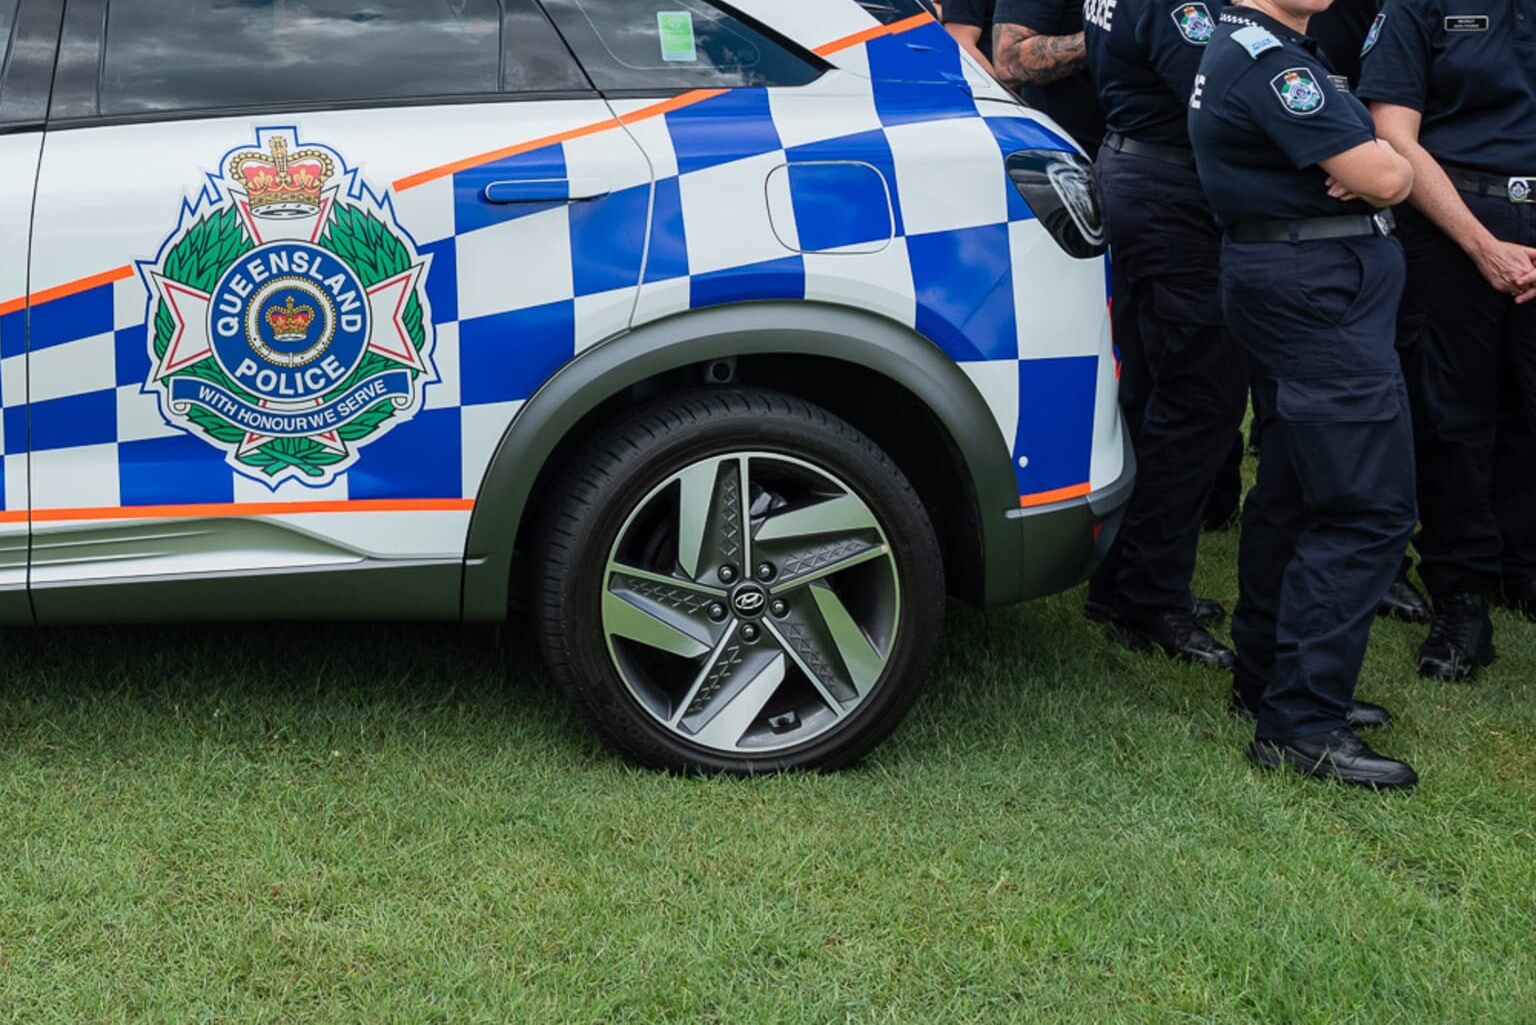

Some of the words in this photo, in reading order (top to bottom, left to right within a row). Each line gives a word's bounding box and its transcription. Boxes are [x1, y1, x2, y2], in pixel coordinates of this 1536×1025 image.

[216, 250, 362, 337] QUEENSLAND
[234, 354, 346, 395] POLICE
[198, 385, 237, 416] WITH
[237, 407, 307, 431] HONOUR
[308, 409, 337, 428] WE
[337, 379, 387, 416] SERVE
